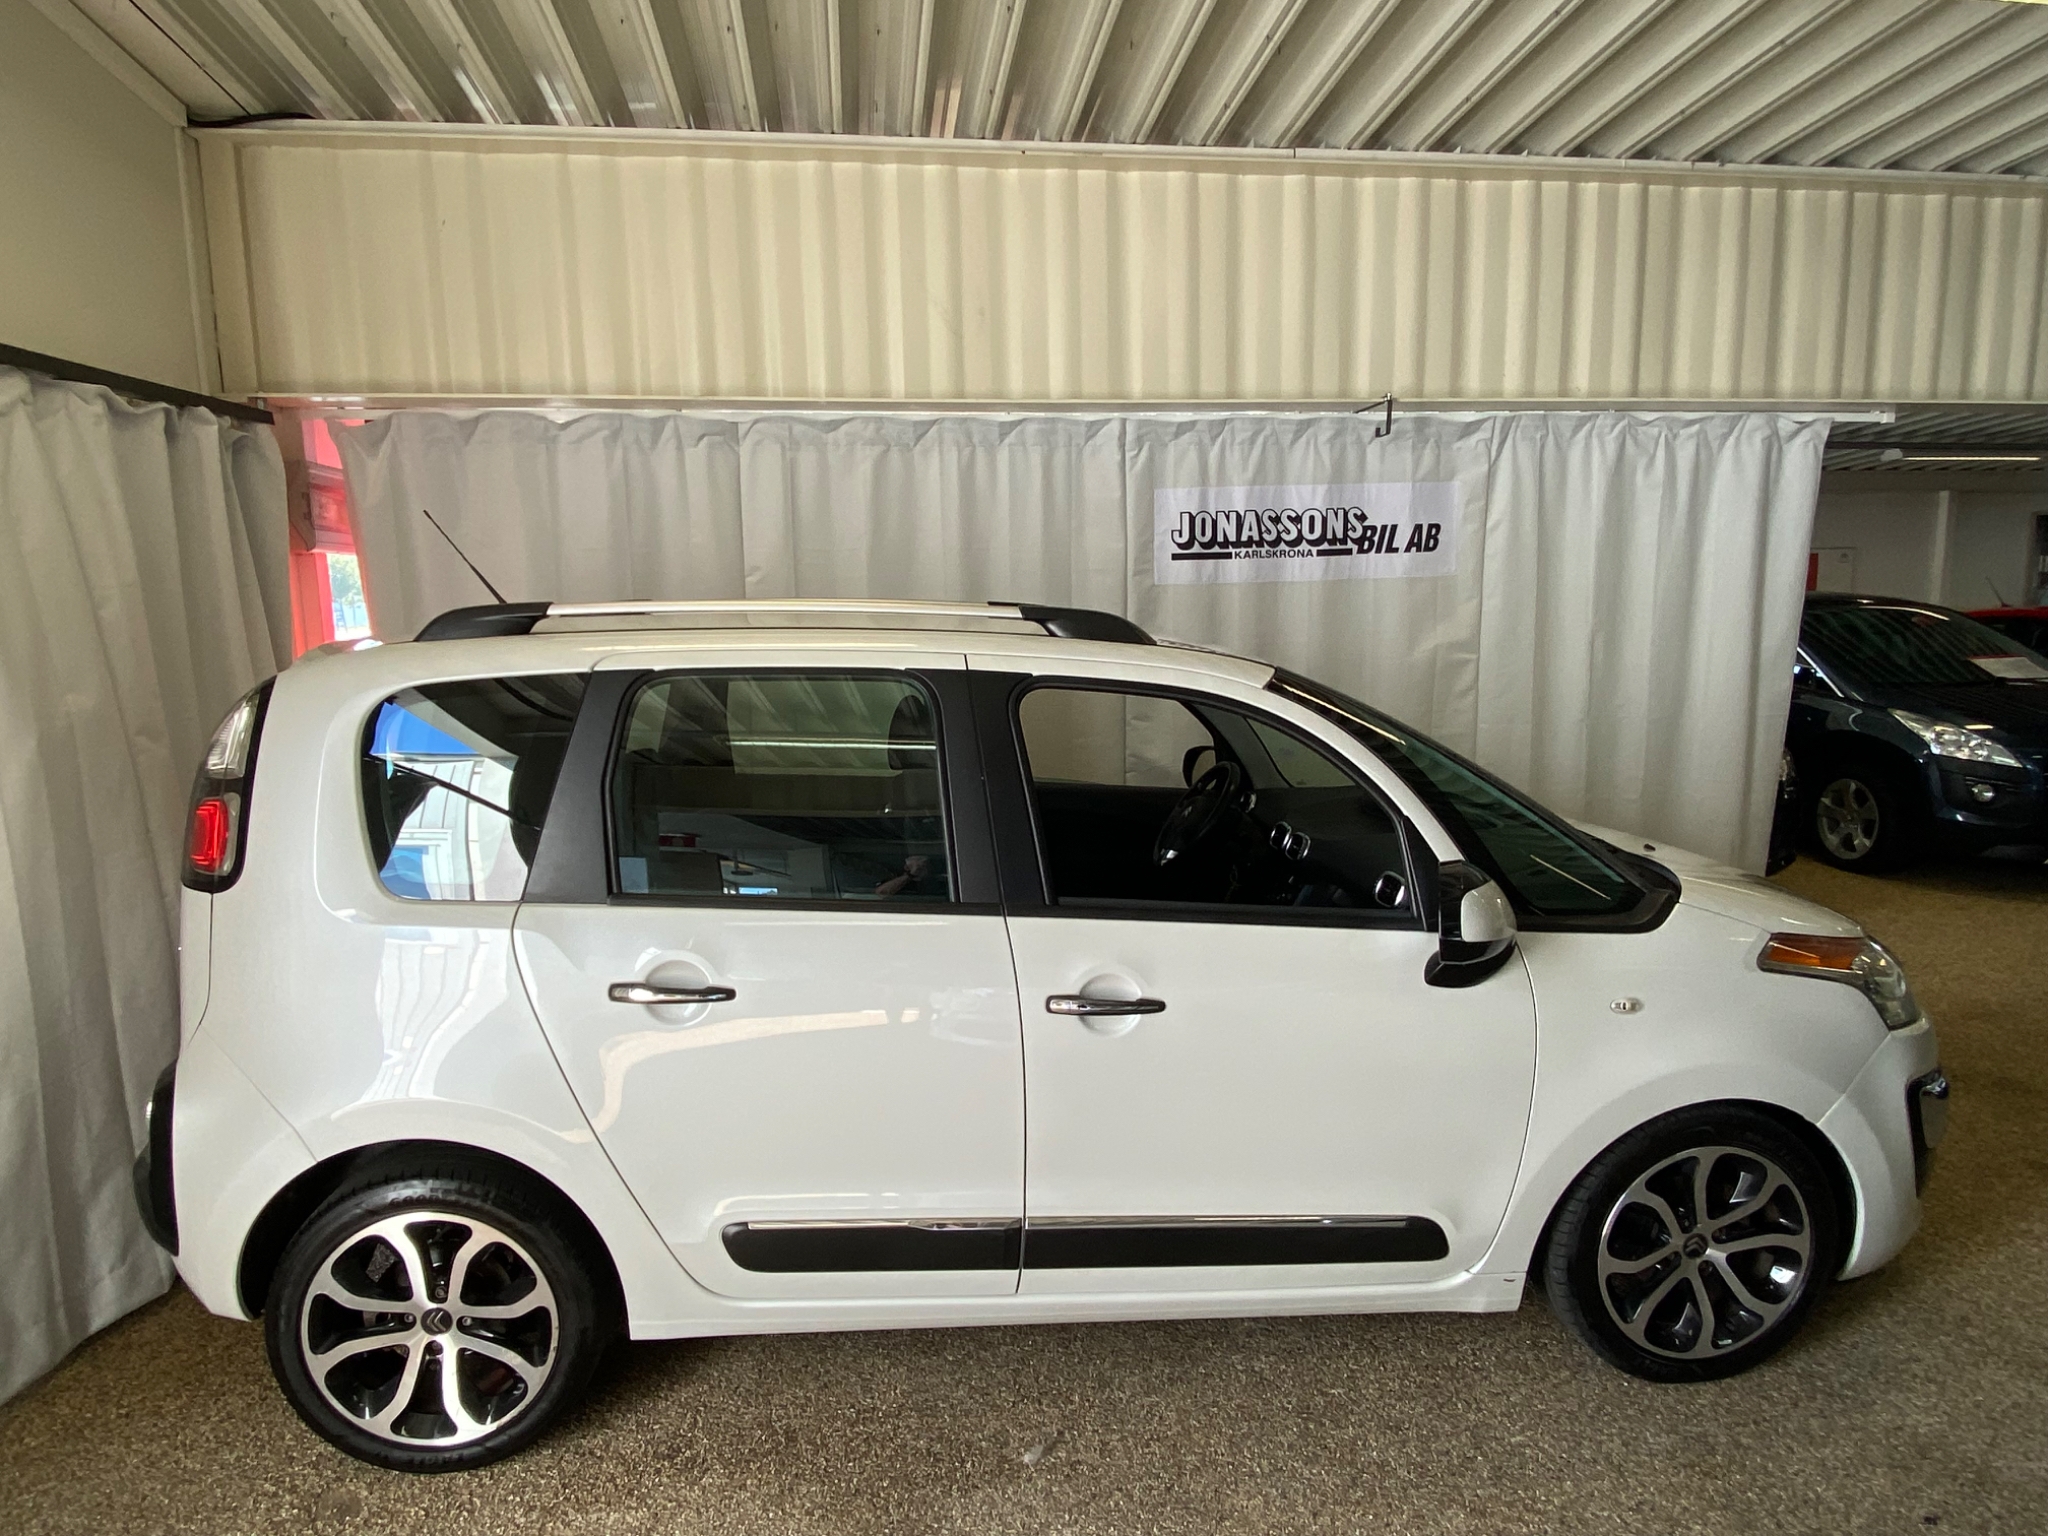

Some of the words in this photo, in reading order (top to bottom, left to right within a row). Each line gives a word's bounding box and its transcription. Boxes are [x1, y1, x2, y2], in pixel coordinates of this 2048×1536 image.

[1171, 507, 1368, 550] JONASSONS
[1357, 524, 1399, 554] BIL
[1404, 523, 1441, 553] AB
[1234, 549, 1314, 559] KARLSKRONA
